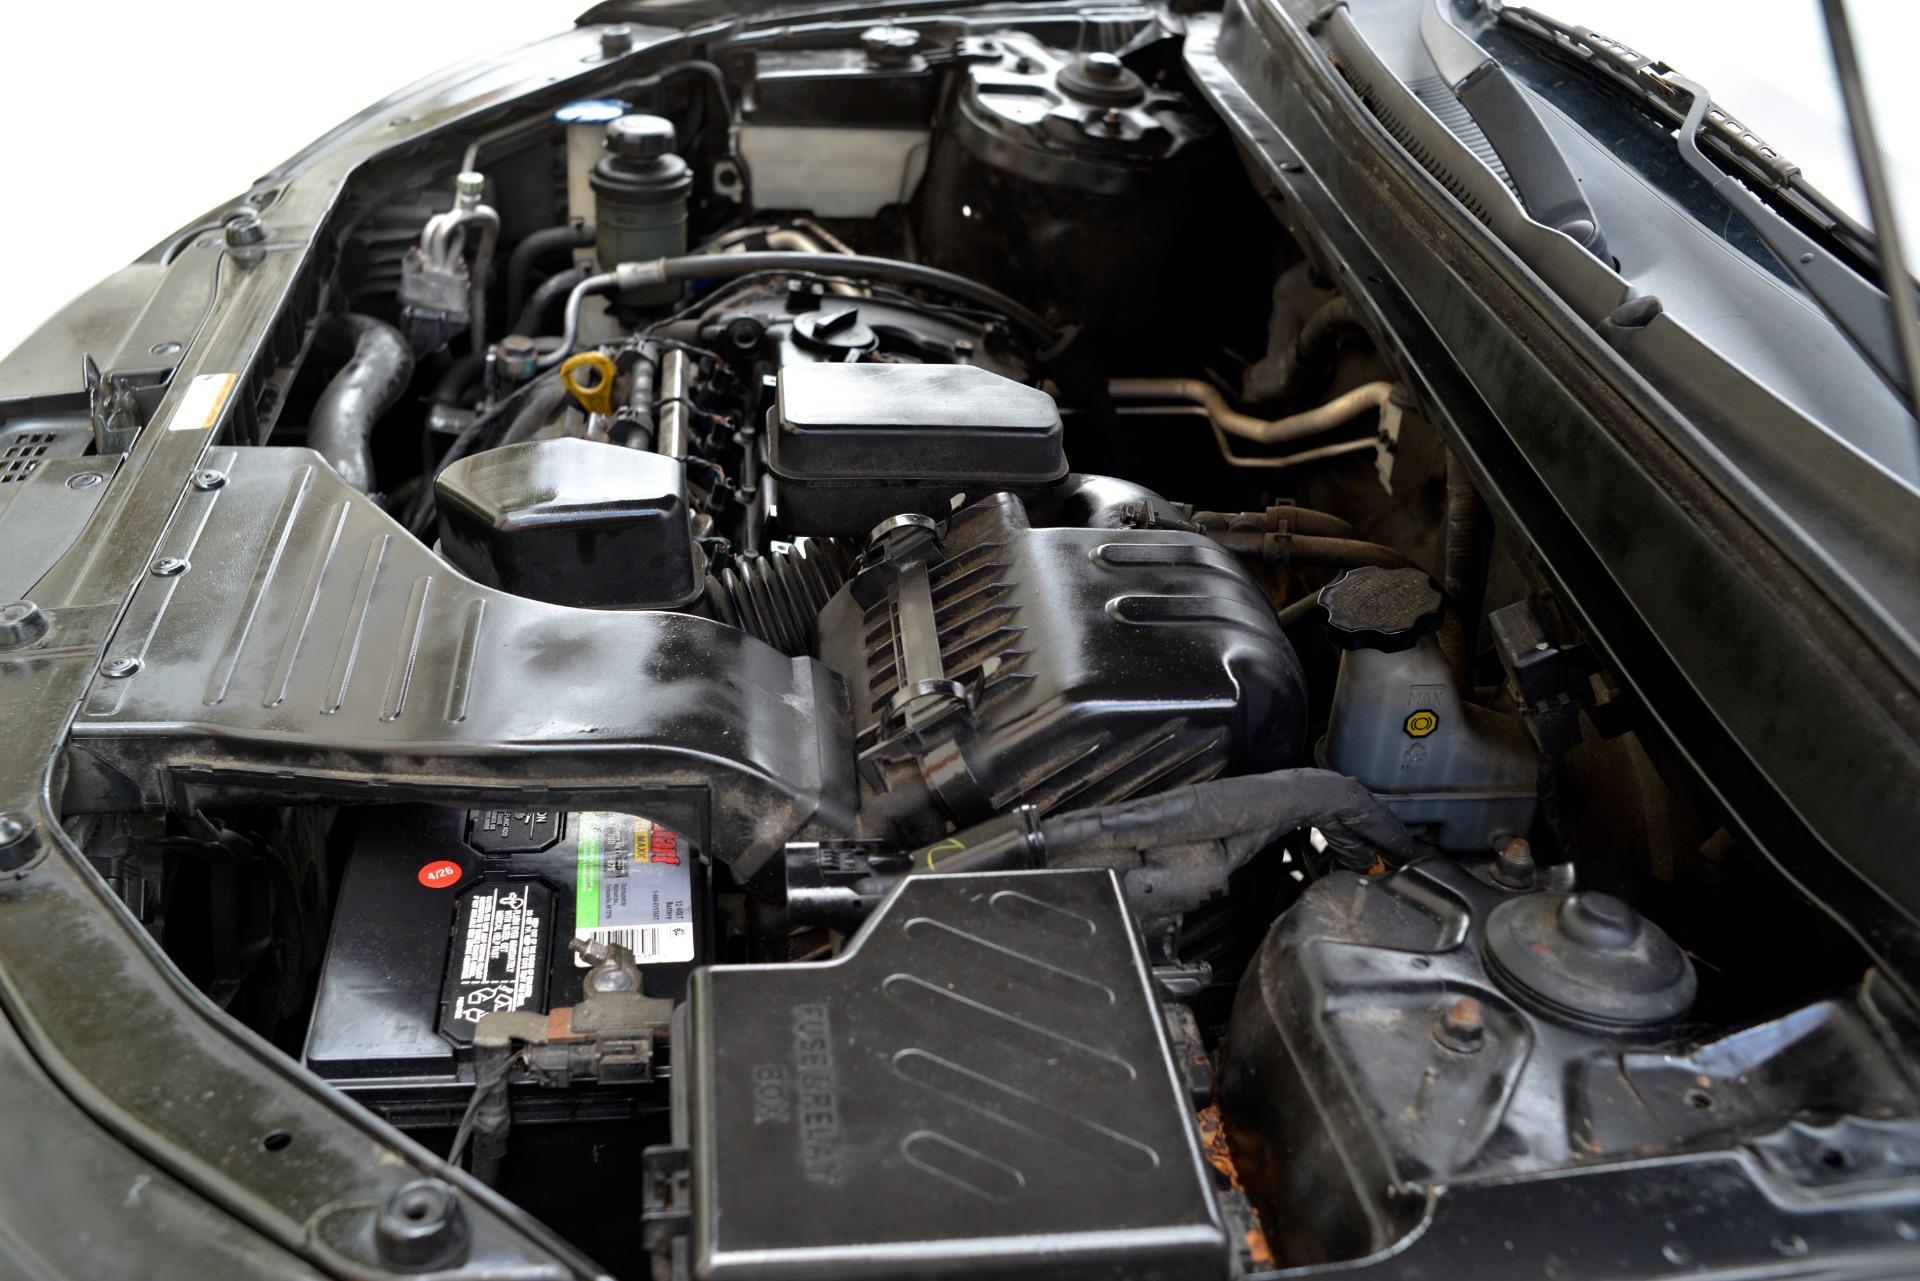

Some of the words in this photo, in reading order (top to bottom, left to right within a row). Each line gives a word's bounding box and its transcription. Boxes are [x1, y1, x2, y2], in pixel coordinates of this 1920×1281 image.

[636, 835, 646, 858] MAXX
[428, 866, 454, 880] 4/26
[665, 902, 673, 919] Battery
[675, 901, 683, 919] 12-VOLT
[500, 942, 509, 952] GET
[754, 1066, 788, 1126] BOX
